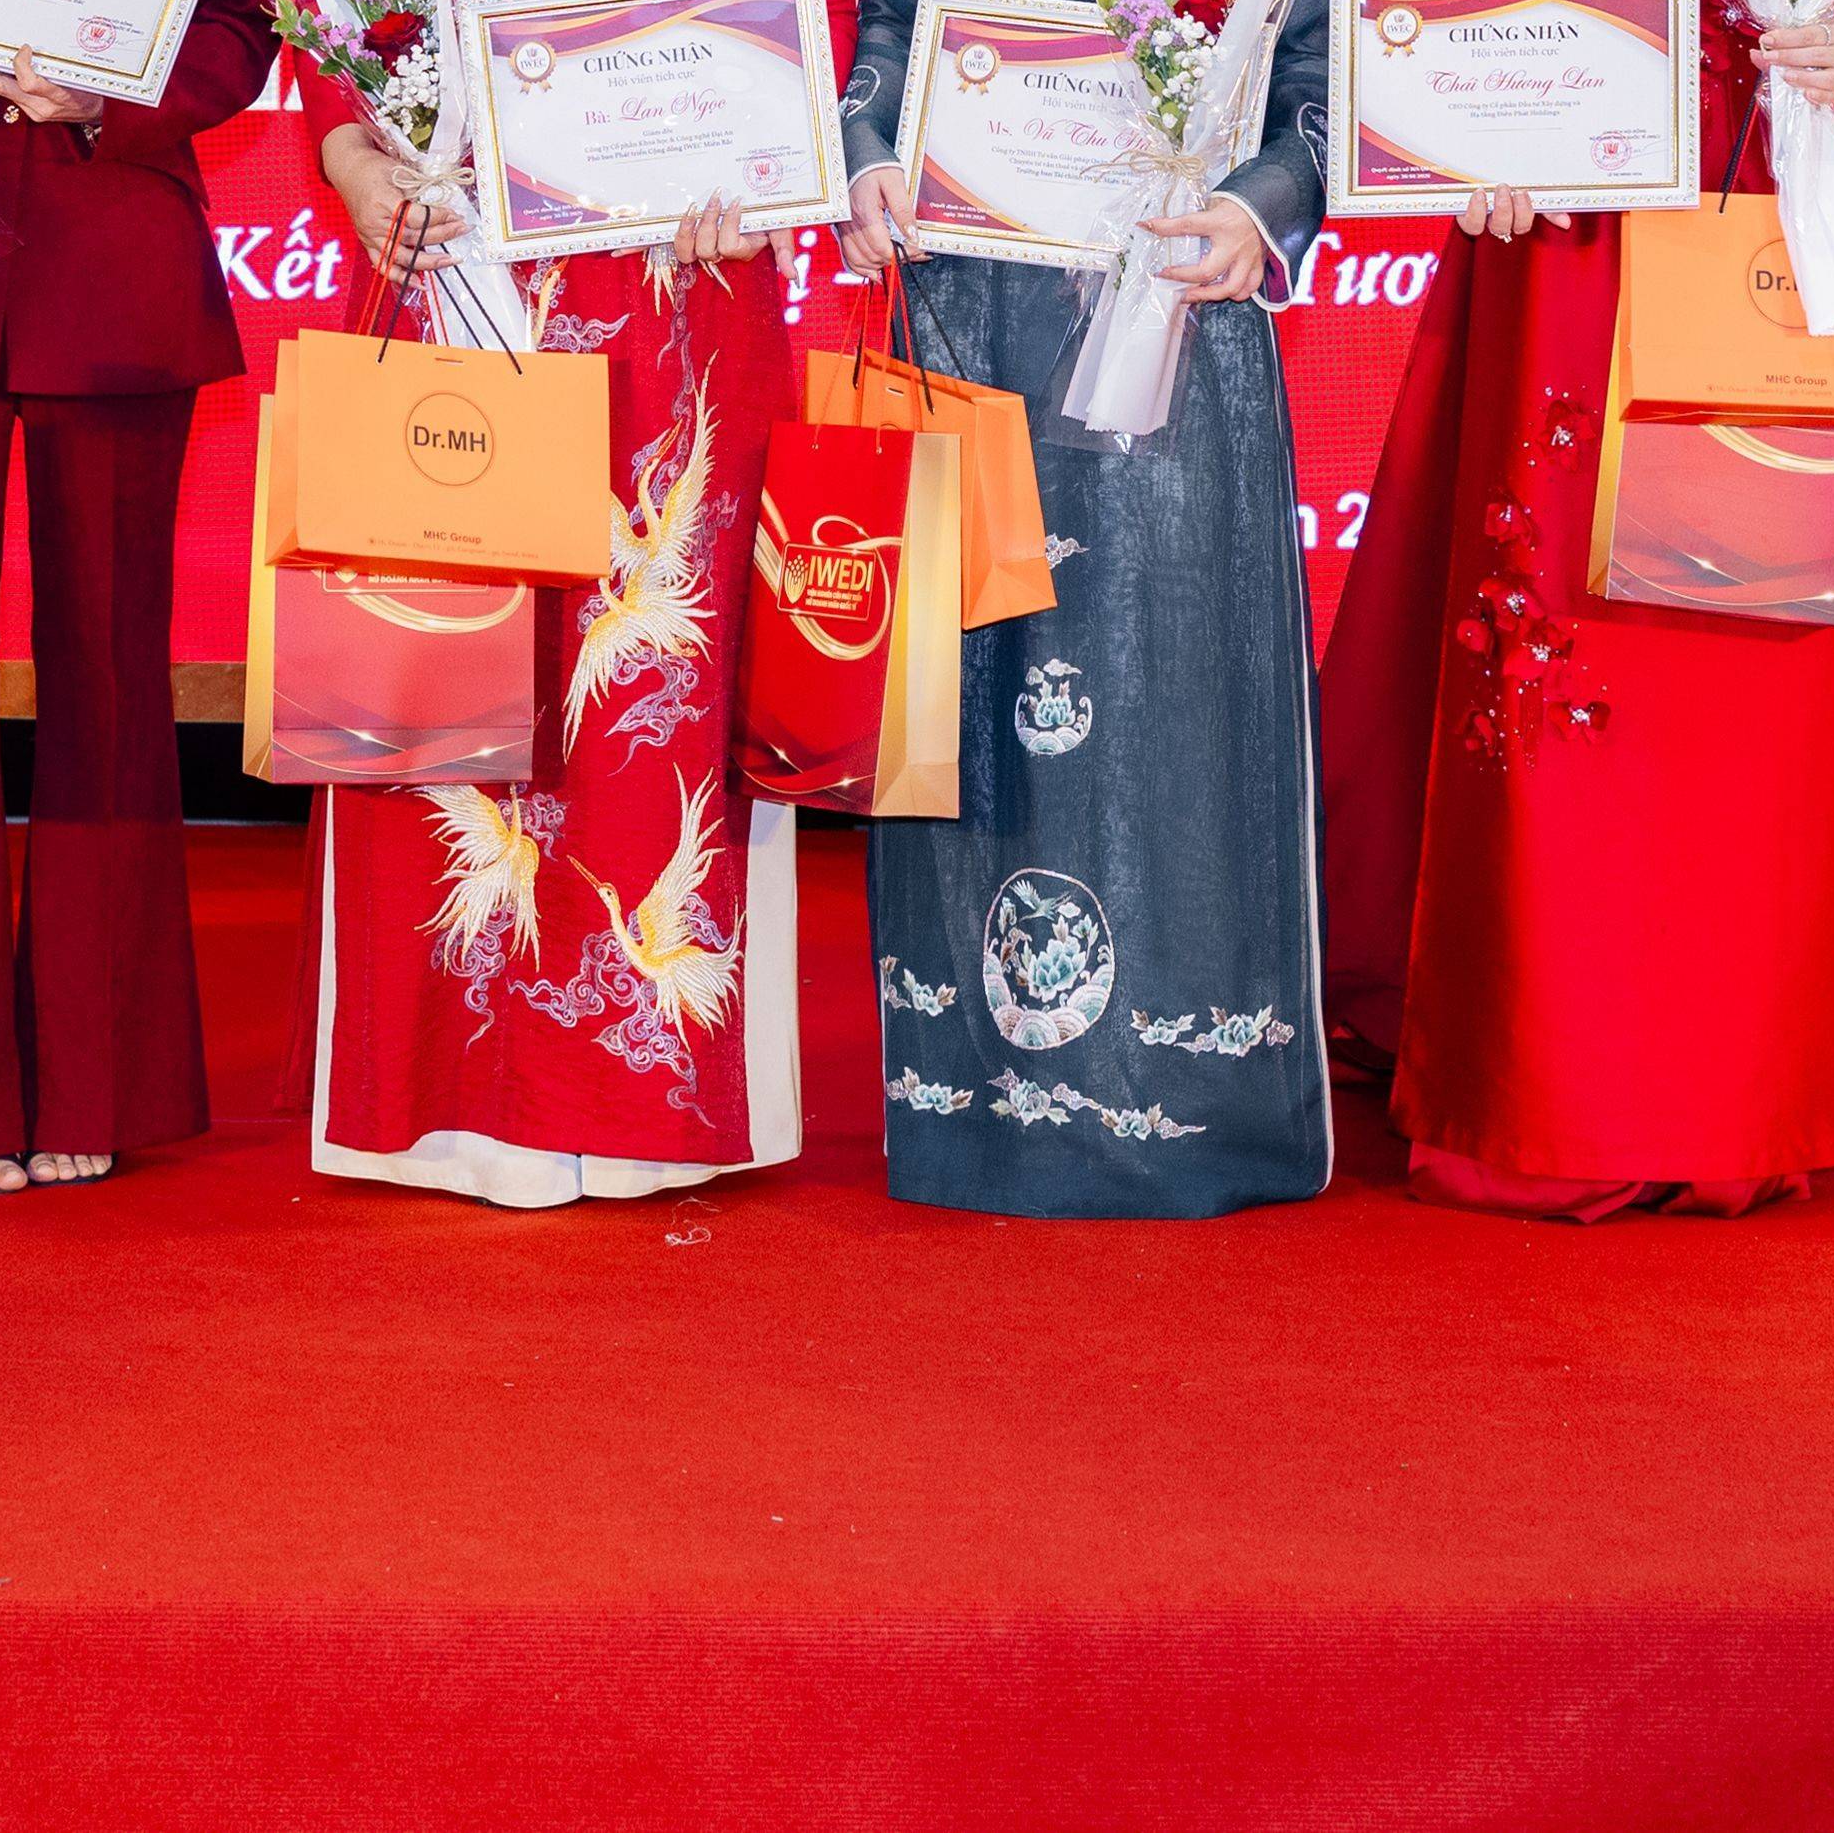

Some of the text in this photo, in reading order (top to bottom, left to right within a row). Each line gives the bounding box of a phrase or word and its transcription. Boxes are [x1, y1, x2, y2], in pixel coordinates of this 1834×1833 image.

[1386, 24, 1412, 33] IWEC
[1448, 21, 1580, 43] CHỨNG NHẬN
[520, 57, 546, 69] IWEC
[583, 41, 714, 74] CHỨNG NHẬN
[1471, 48, 1491, 59] Hội
[1493, 47, 1517, 58] viên
[1519, 46, 1539, 57] tích
[964, 60, 990, 71] IWEC
[607, 75, 629, 88] Hội
[631, 72, 653, 85] viên
[655, 69, 676, 82] tích
[1023, 72, 1091, 94] CHỨNG
[1426, 66, 1605, 98] Thái Hương Lan
[619, 96, 664, 122] Lan
[670, 88, 727, 122] Ngọc
[1041, 96, 1061, 108] Hội
[1063, 99, 1086, 111] viên
[217, 209, 341, 301] Kết
[1293, 230, 1442, 307] Tươ
[1756, 270, 1798, 291] Dr.
[1766, 374, 1828, 387] MHC Group
[413, 425, 486, 453] Dr.MH
[423, 530, 482, 545] MHC Group
[807, 555, 874, 592] IWEDI
